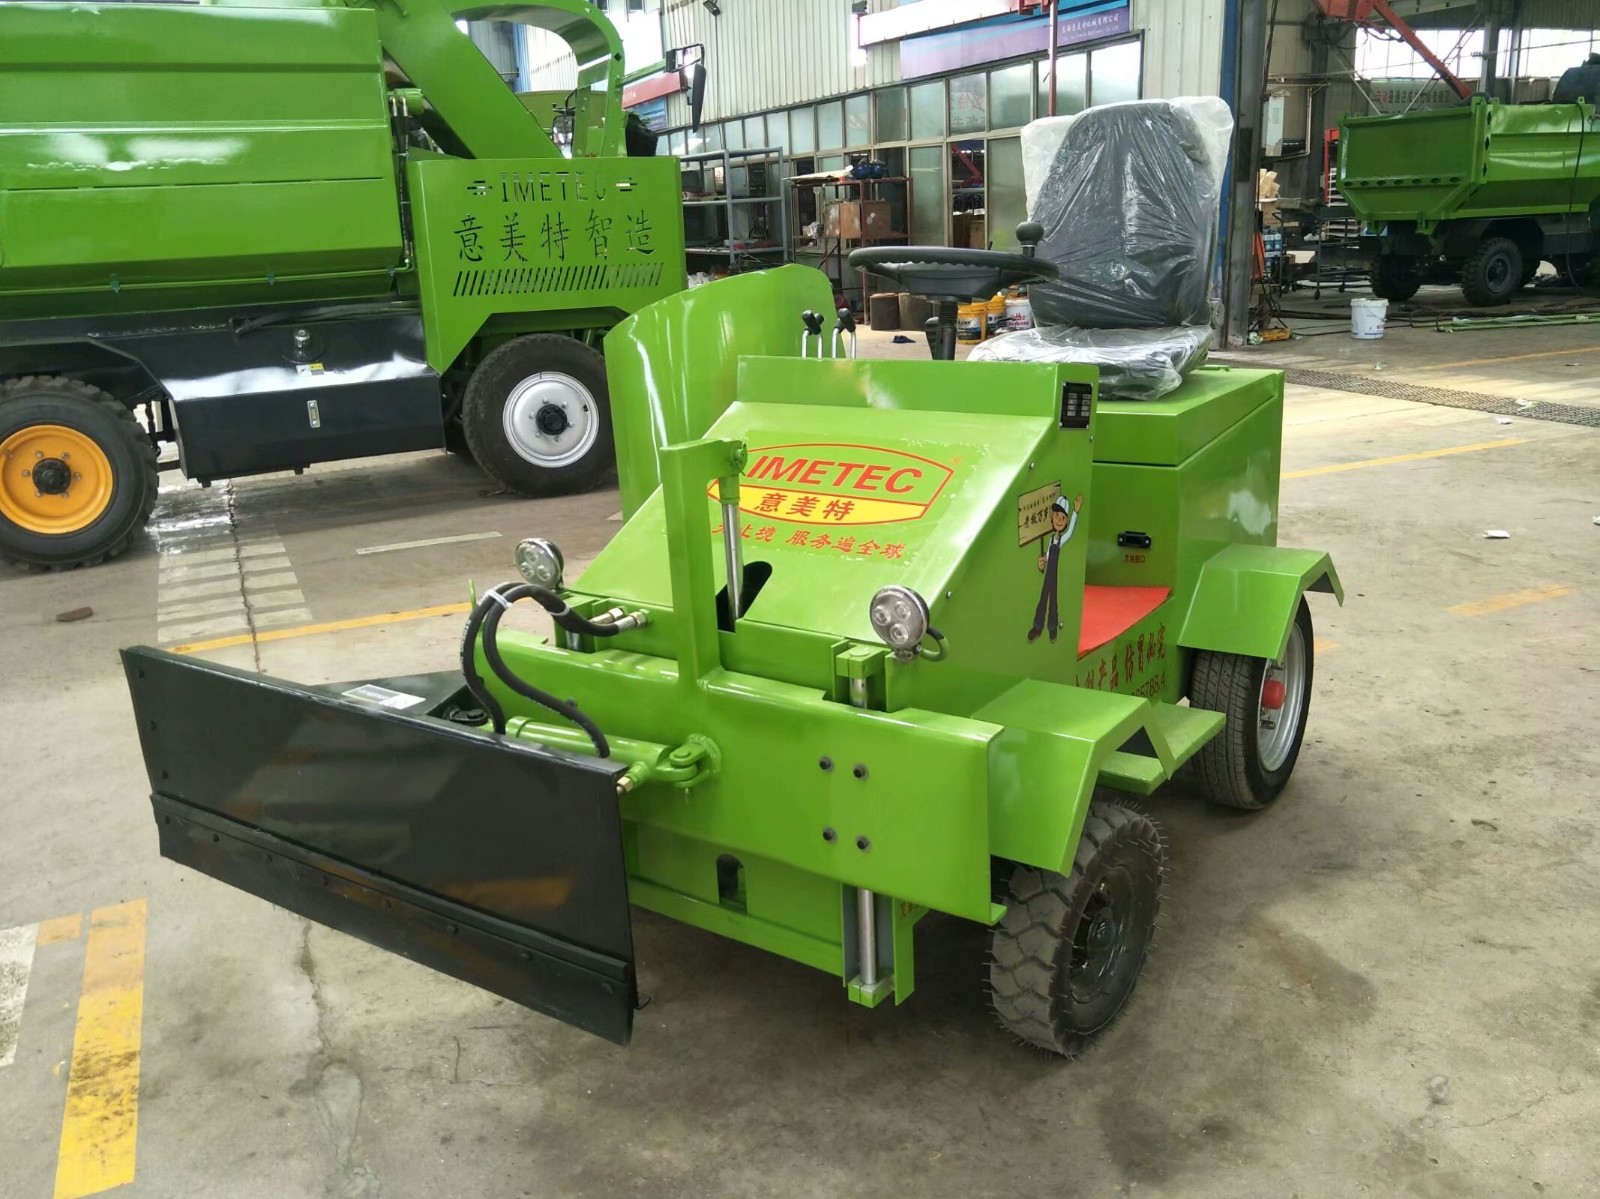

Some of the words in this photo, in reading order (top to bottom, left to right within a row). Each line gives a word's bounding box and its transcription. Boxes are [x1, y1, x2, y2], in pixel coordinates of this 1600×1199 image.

[453, 208, 655, 262] 意美特智造
[746, 455, 923, 493] IMETEC
[754, 492, 854, 521] 意美特
[786, 529, 906, 559] 服务遍全球
